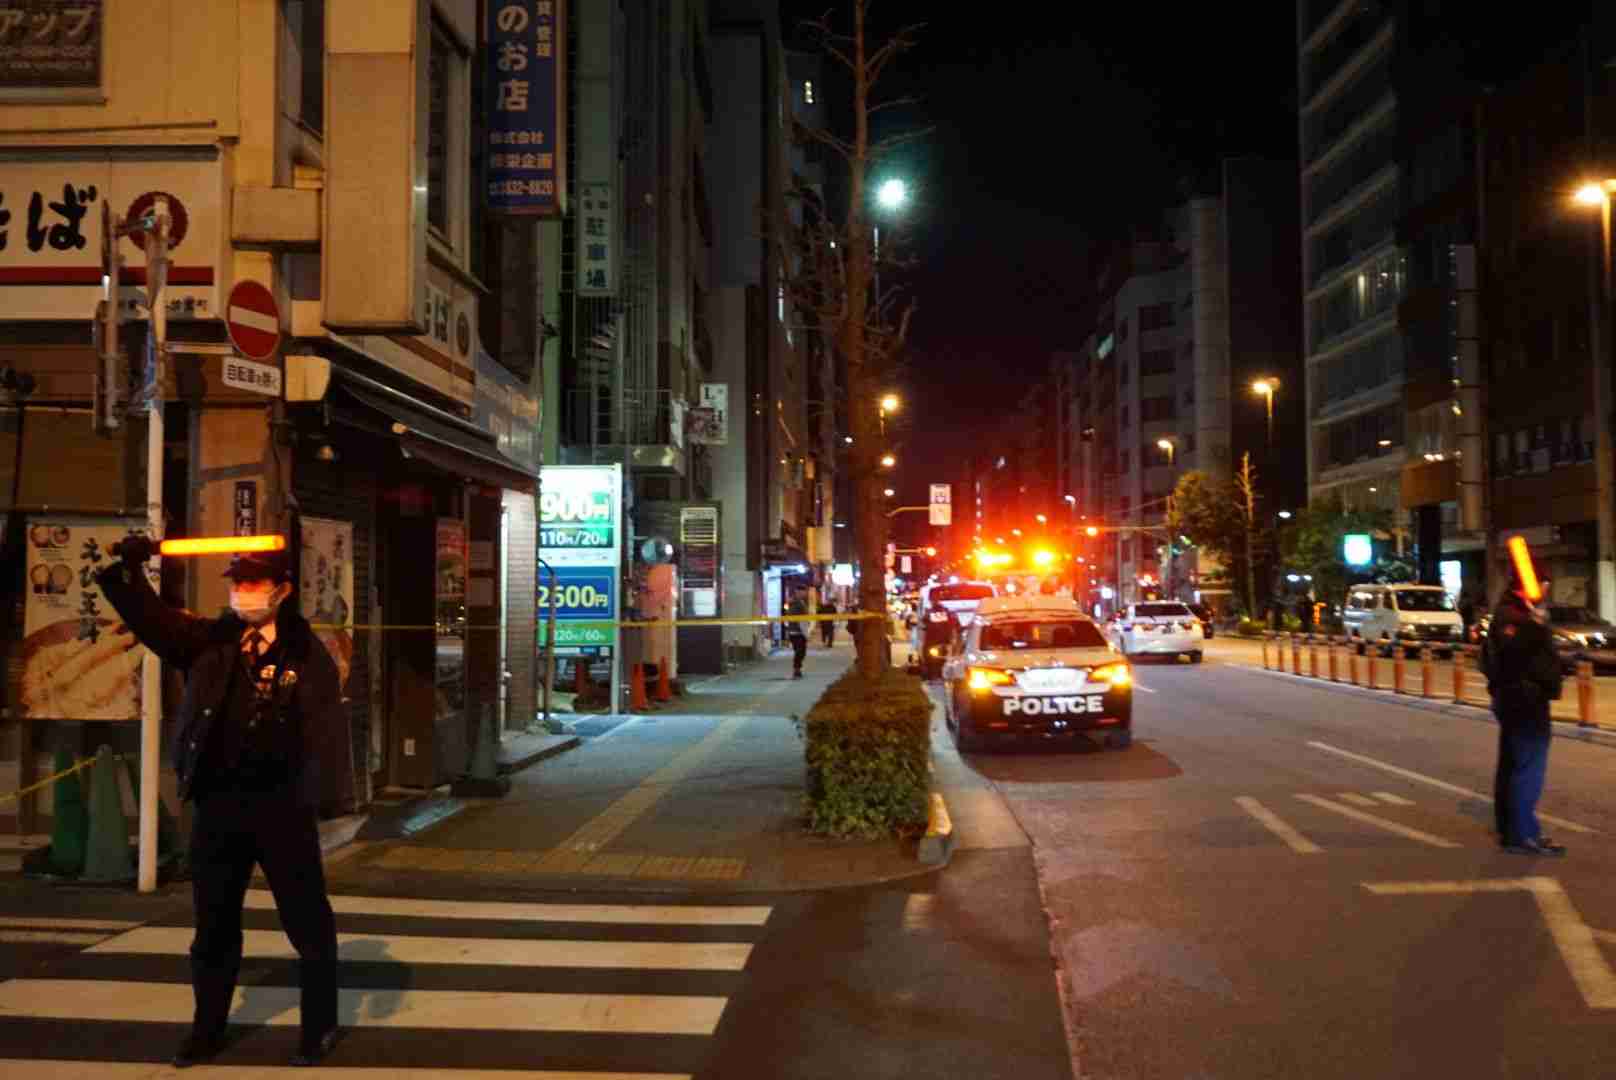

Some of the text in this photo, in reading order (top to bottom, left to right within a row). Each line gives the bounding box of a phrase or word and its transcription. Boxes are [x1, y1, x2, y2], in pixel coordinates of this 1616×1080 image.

[585, 216, 607, 289] 駐車場
[1002, 695, 1104, 716] POLICE
